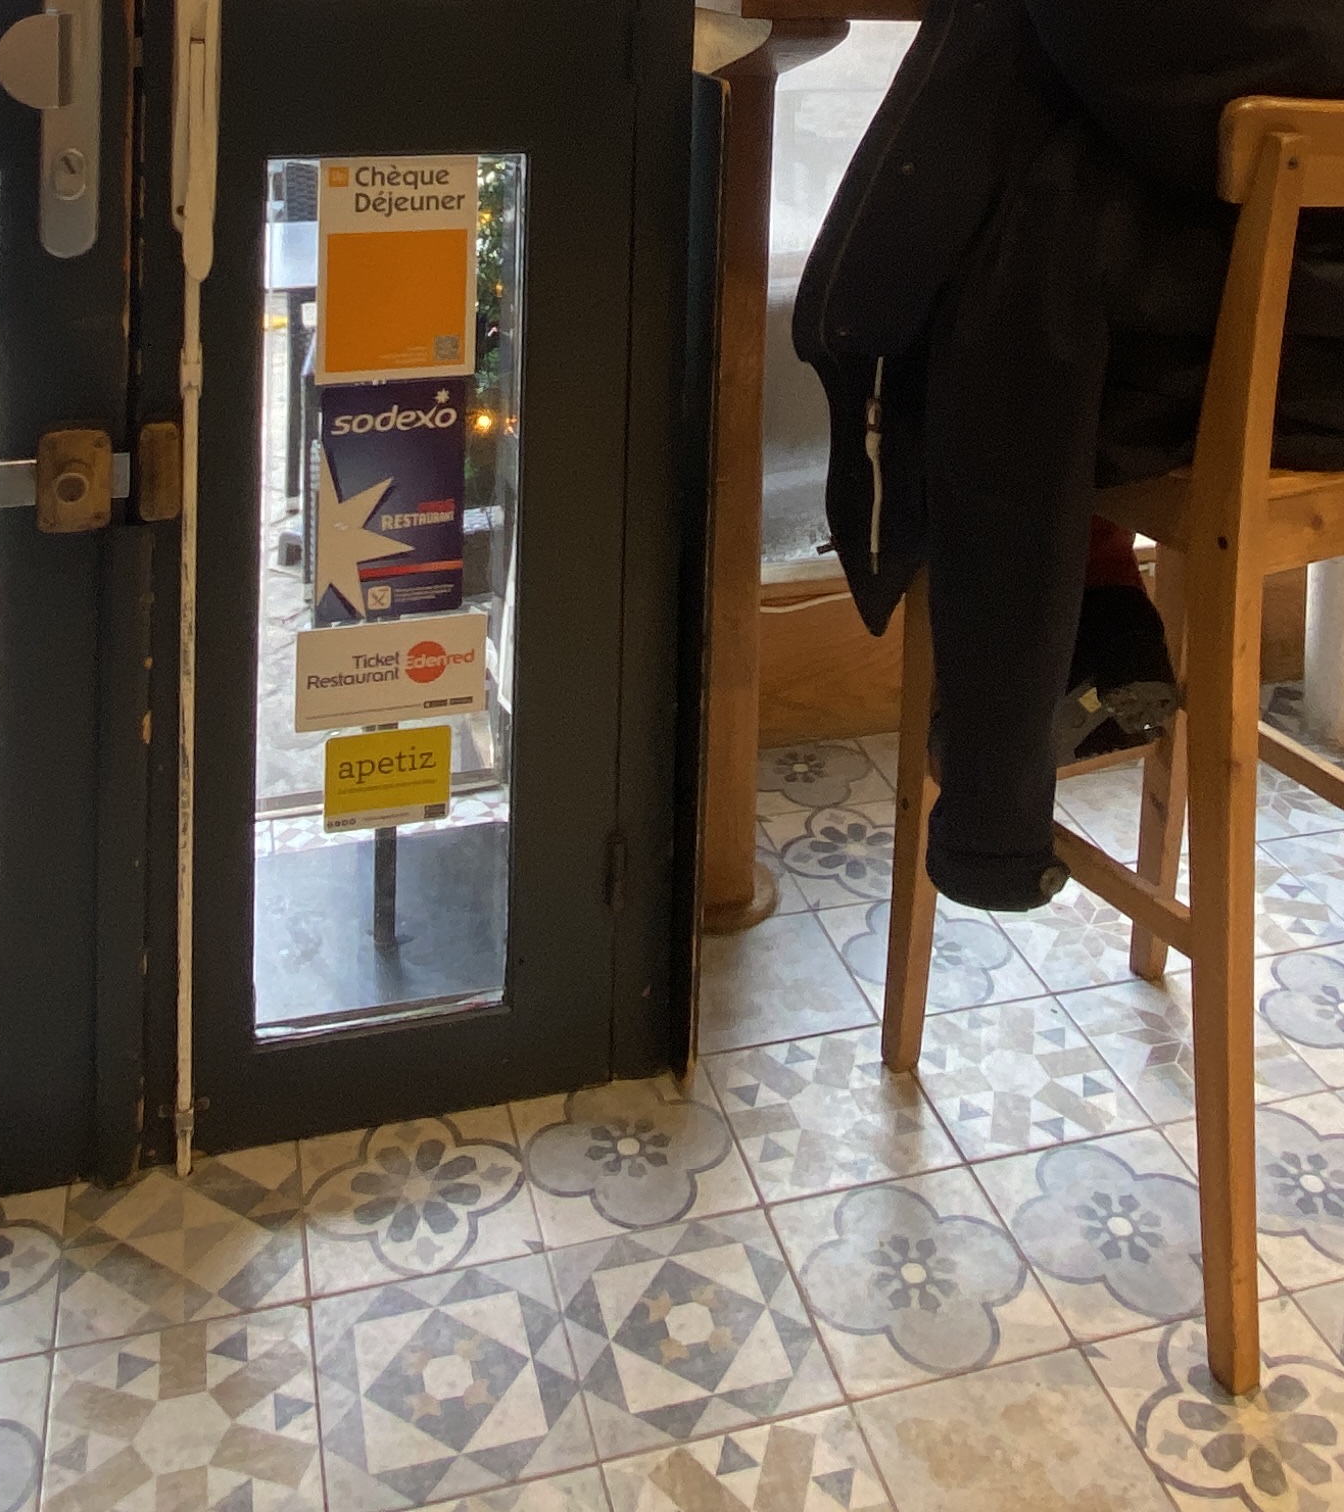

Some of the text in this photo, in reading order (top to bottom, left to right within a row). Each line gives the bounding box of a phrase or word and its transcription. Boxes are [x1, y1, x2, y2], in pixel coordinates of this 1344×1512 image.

[354, 163, 450, 190] Chèque
[354, 190, 466, 218] Déjeuner
[330, 404, 458, 436] sodexo
[351, 648, 476, 670] Ticket Edenred
[306, 667, 401, 691] Restaurant
[338, 745, 437, 785] apetiz
